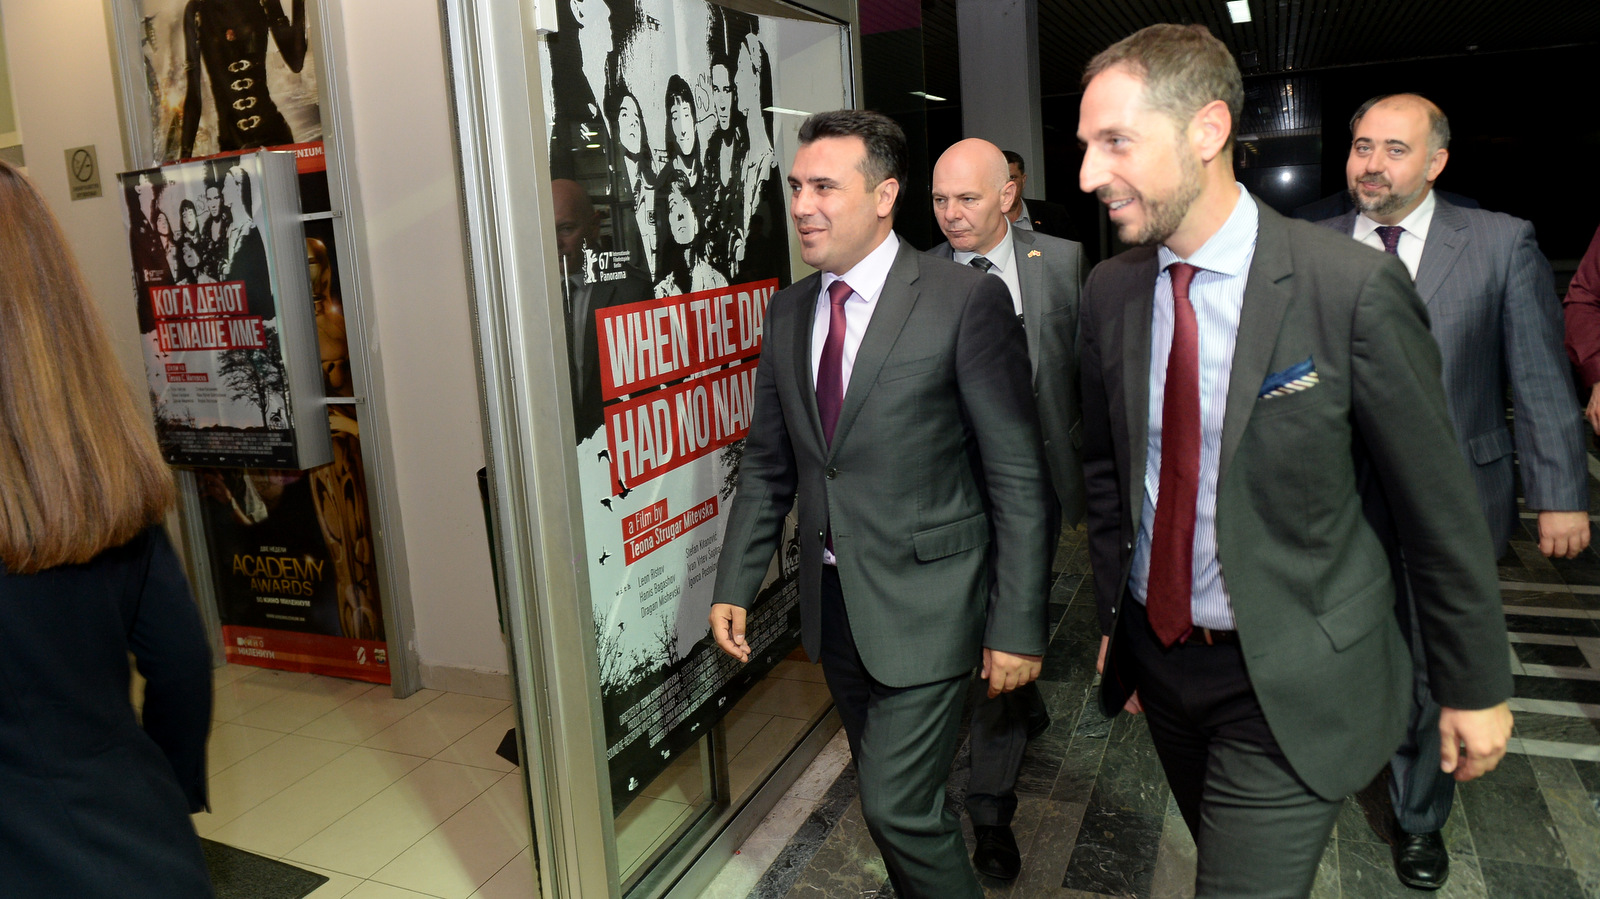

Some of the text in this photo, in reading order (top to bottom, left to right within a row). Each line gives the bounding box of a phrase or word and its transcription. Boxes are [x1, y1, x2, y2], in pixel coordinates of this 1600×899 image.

[599, 270, 627, 282] Panorama
[152, 284, 243, 316] КОГА ДЕНОТ
[158, 318, 264, 349] НЕМАШЕ ИМЕ
[604, 302, 690, 389] WHEN
[690, 293, 737, 363] THE
[612, 367, 757, 482] HAD NO NAM
[628, 504, 663, 535] a Film by
[630, 502, 714, 558] Teona Strugar Mitevska
[232, 554, 324, 581] ACADEMY
[638, 564, 665, 588] Leon Ristov
[250, 578, 314, 596] AWARDS
[640, 584, 681, 618] Dragan Mishevski
